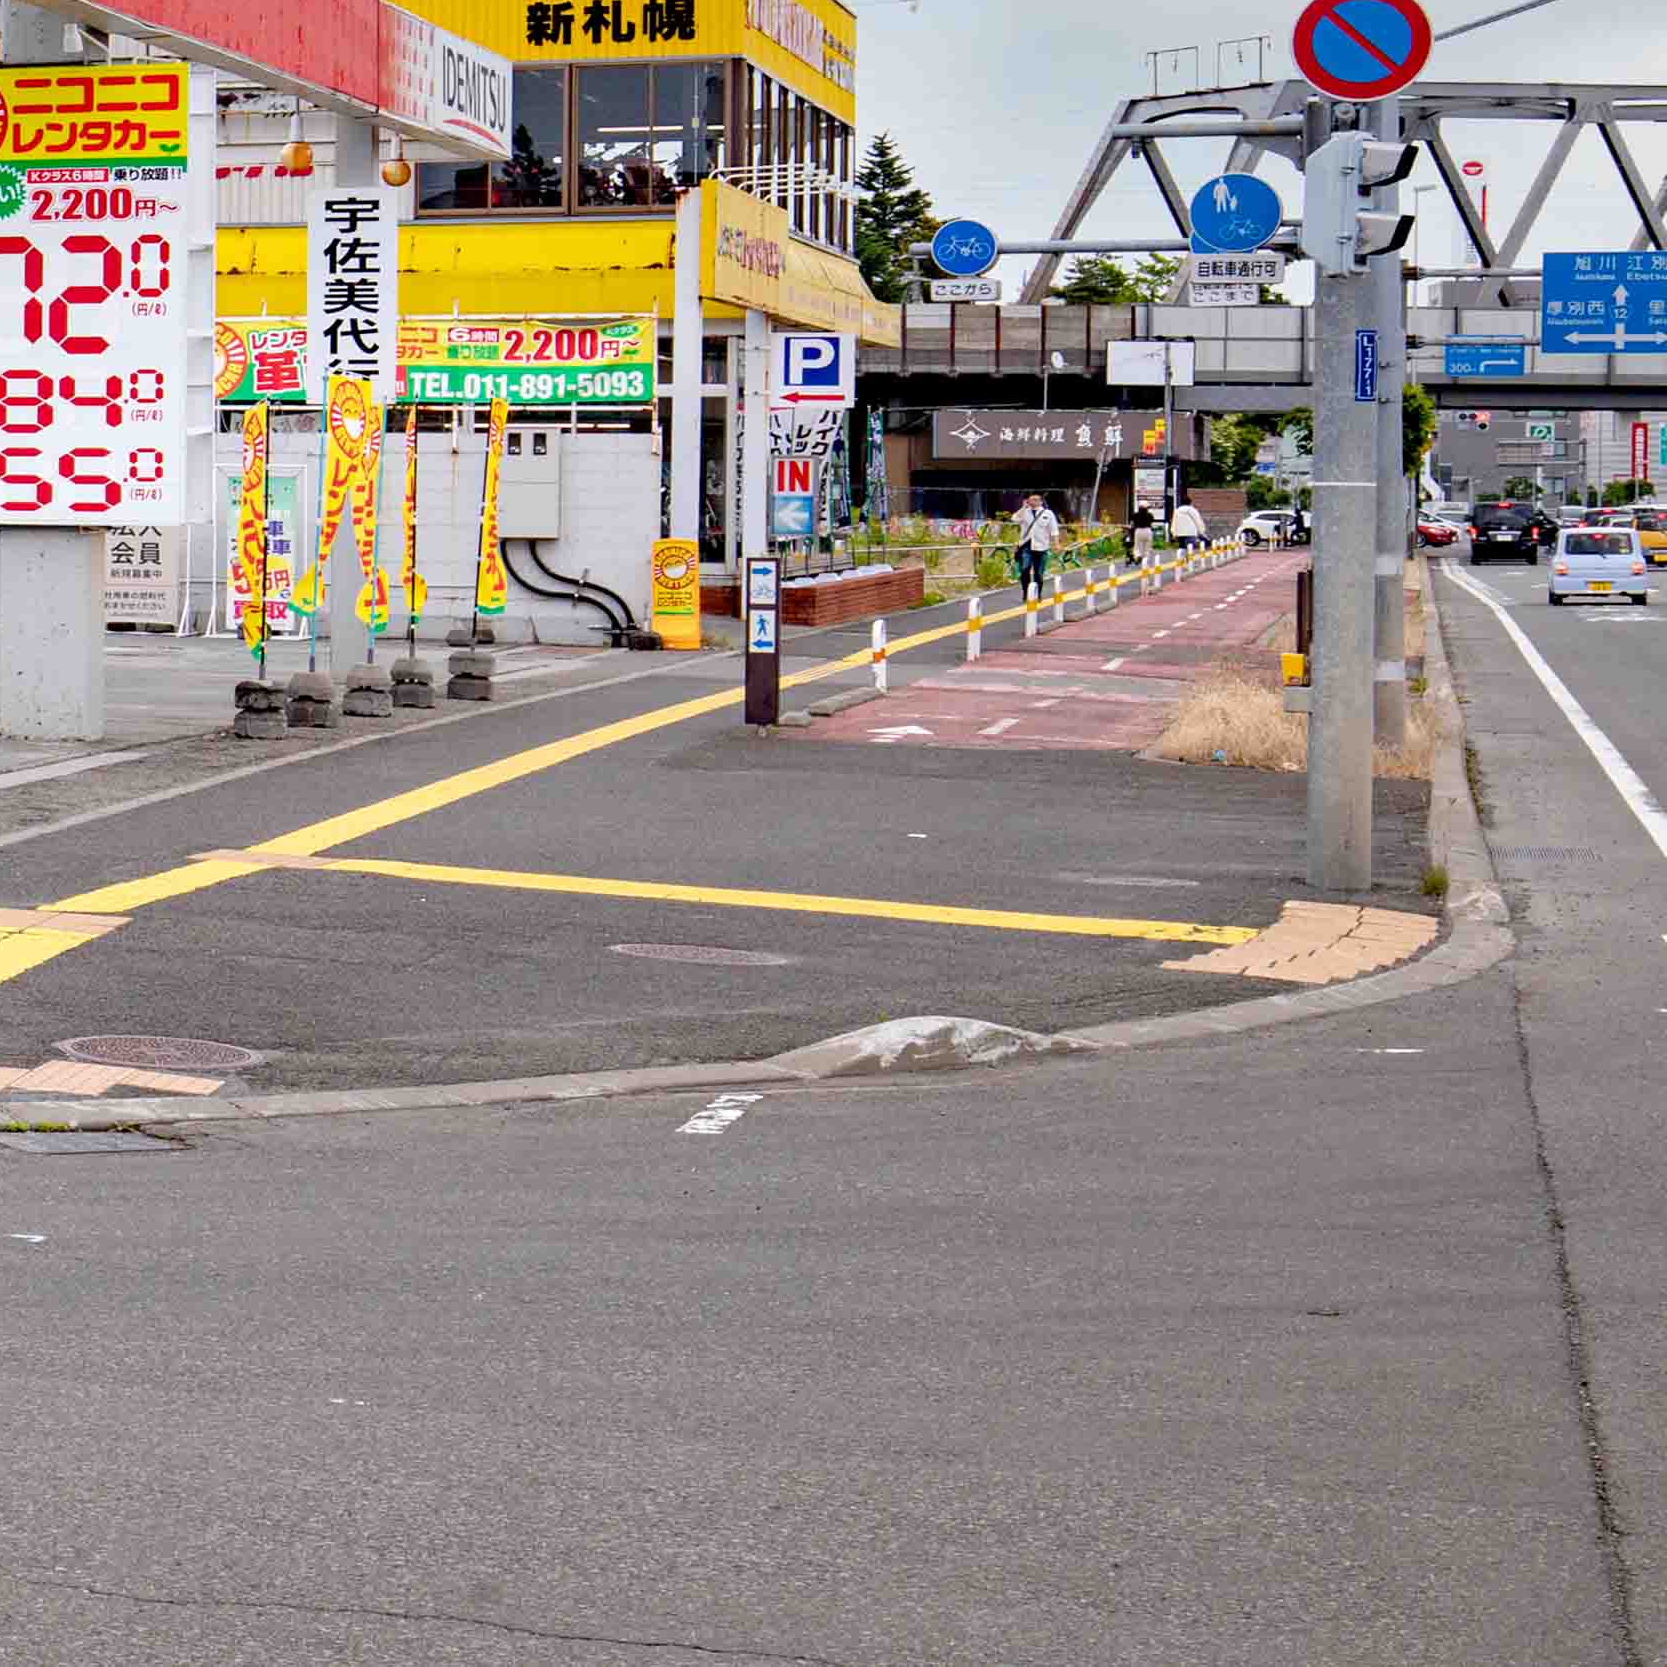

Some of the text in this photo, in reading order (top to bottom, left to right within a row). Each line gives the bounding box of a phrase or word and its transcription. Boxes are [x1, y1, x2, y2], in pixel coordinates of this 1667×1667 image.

[12, 74, 181, 114] ニコニコ
[442, 45, 506, 133] IDEMITSU
[11, 119, 182, 154] レンタカー
[1198, 261, 1277, 277] 自転車通行可
[935, 283, 993, 295] ここから
[1613, 307, 1627, 319] 12
[788, 338, 836, 386] P
[777, 460, 810, 492] IN
[110, 540, 163, 565] 会員
